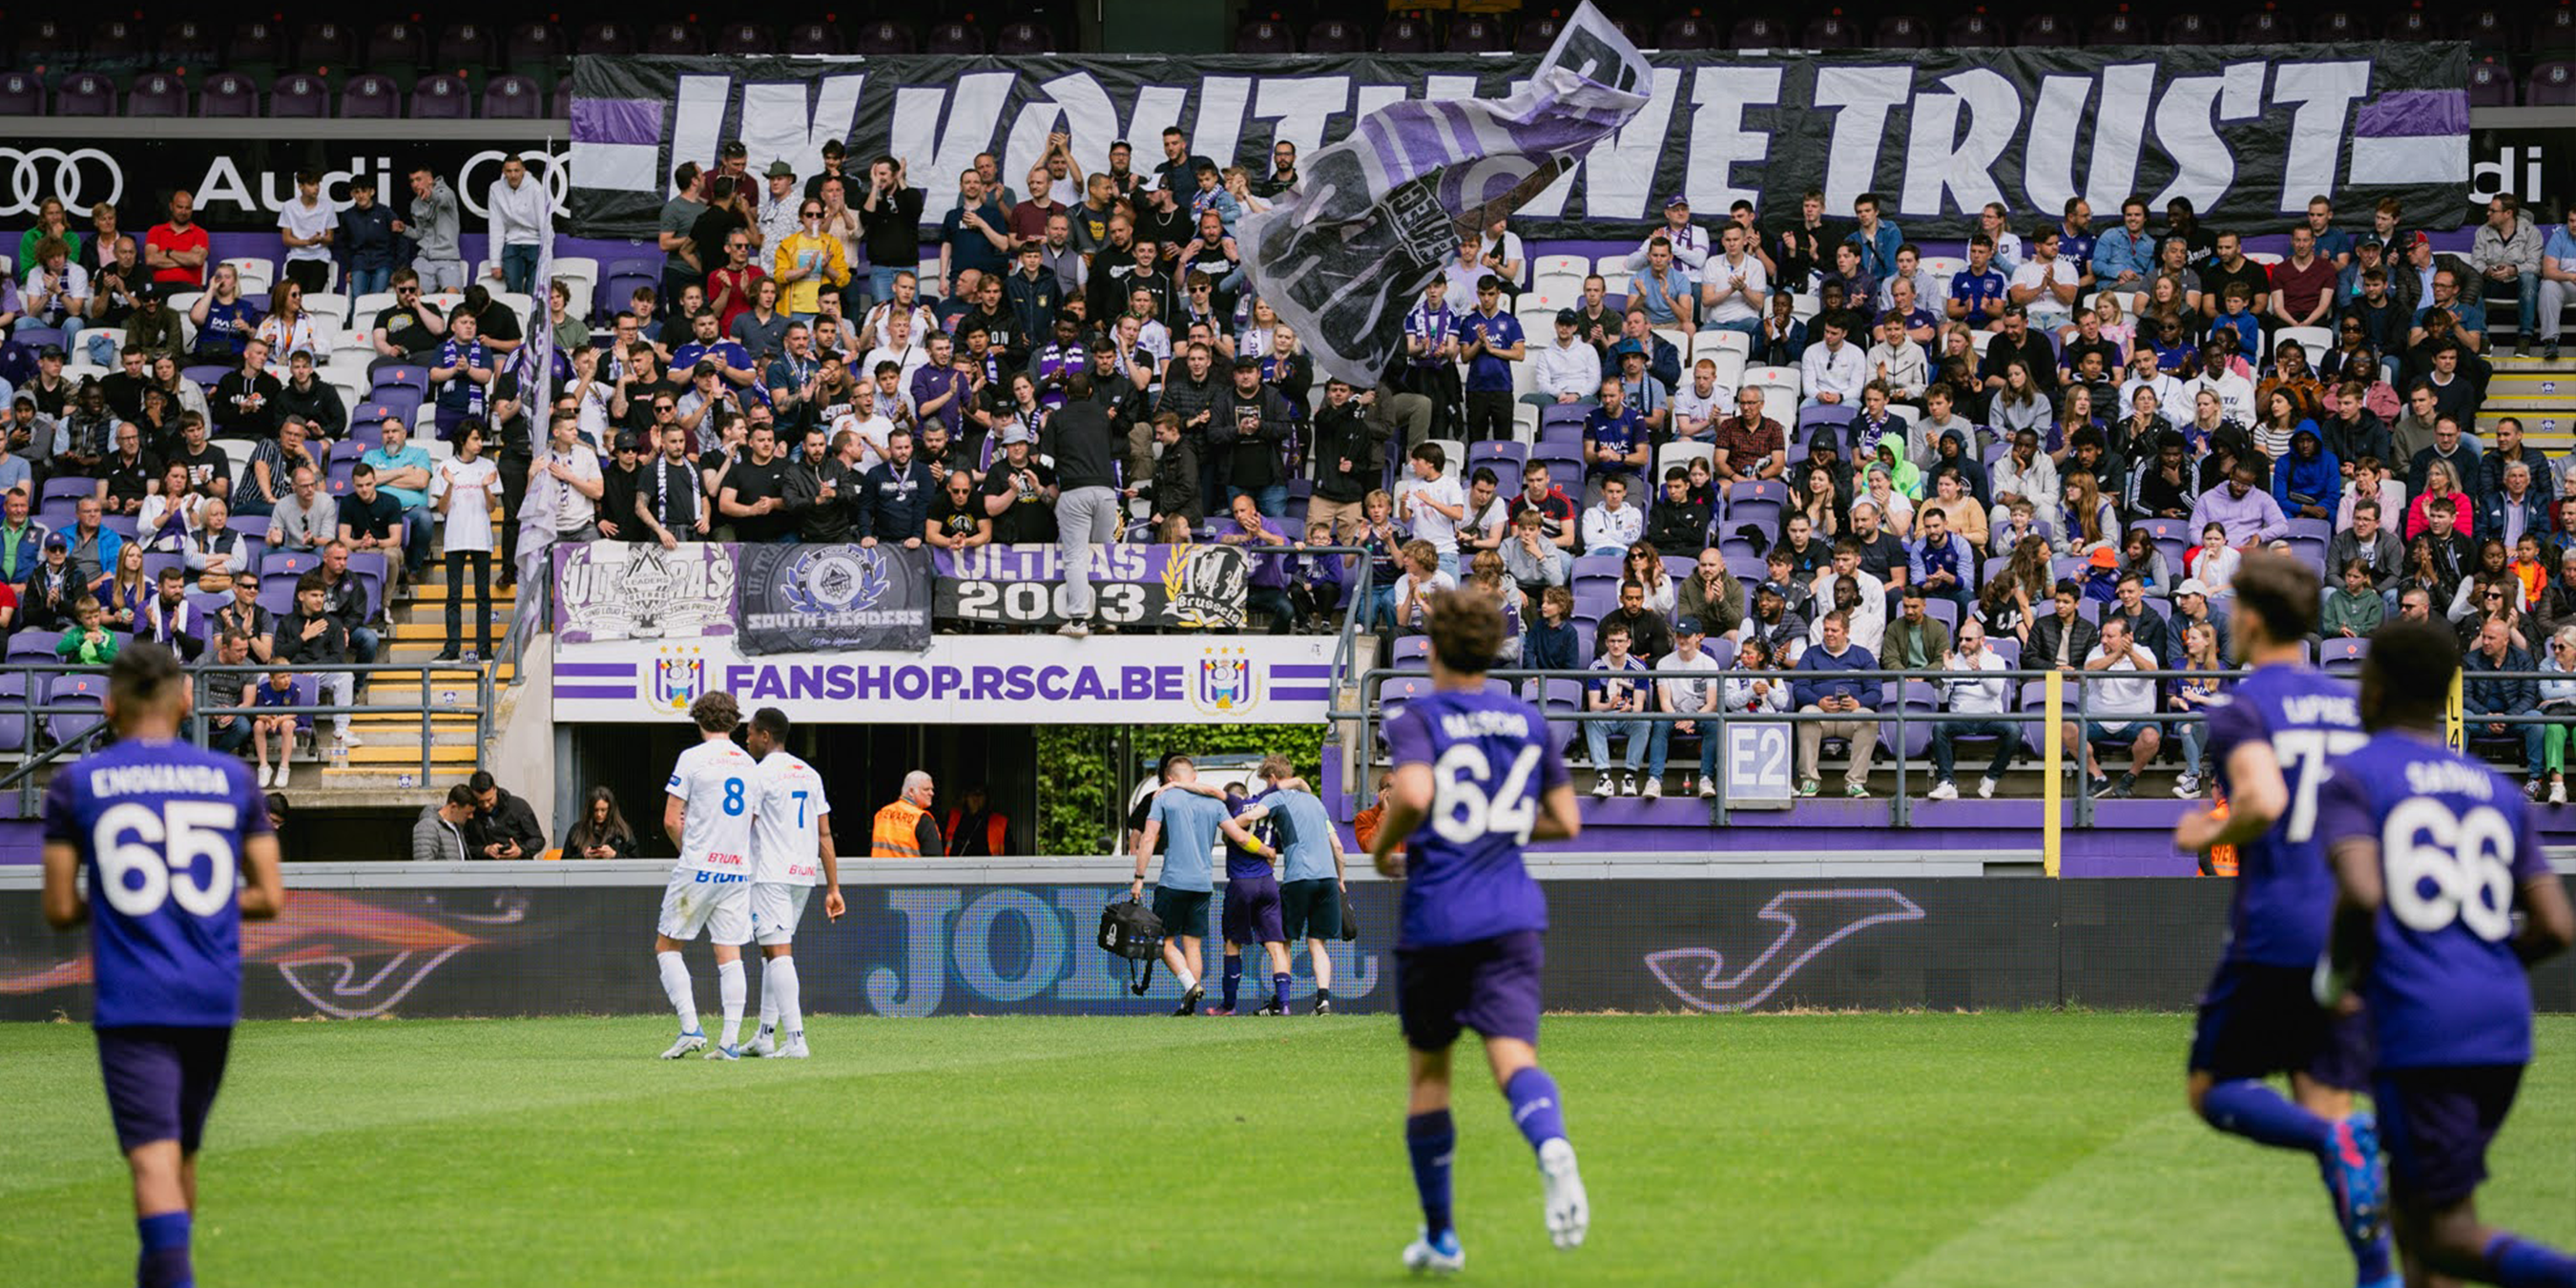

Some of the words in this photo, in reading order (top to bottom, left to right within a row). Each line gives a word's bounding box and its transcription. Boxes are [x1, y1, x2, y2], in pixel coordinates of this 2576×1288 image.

[668, 73, 866, 210] IN
[1813, 59, 2371, 218] TRUST
[957, 580, 1147, 622] 2003
[1177, 594, 1240, 625] Brussels
[726, 665, 1184, 701] FANSHOP.RSCA.BE
[1731, 727, 1786, 785] E2
[2449, 728, 2460, 753] 4
[722, 777, 745, 817] 8
[791, 790, 809, 829] 7
[1432, 743, 1543, 847] 64
[93, 800, 238, 918] 65
[2382, 796, 2516, 943] 66
